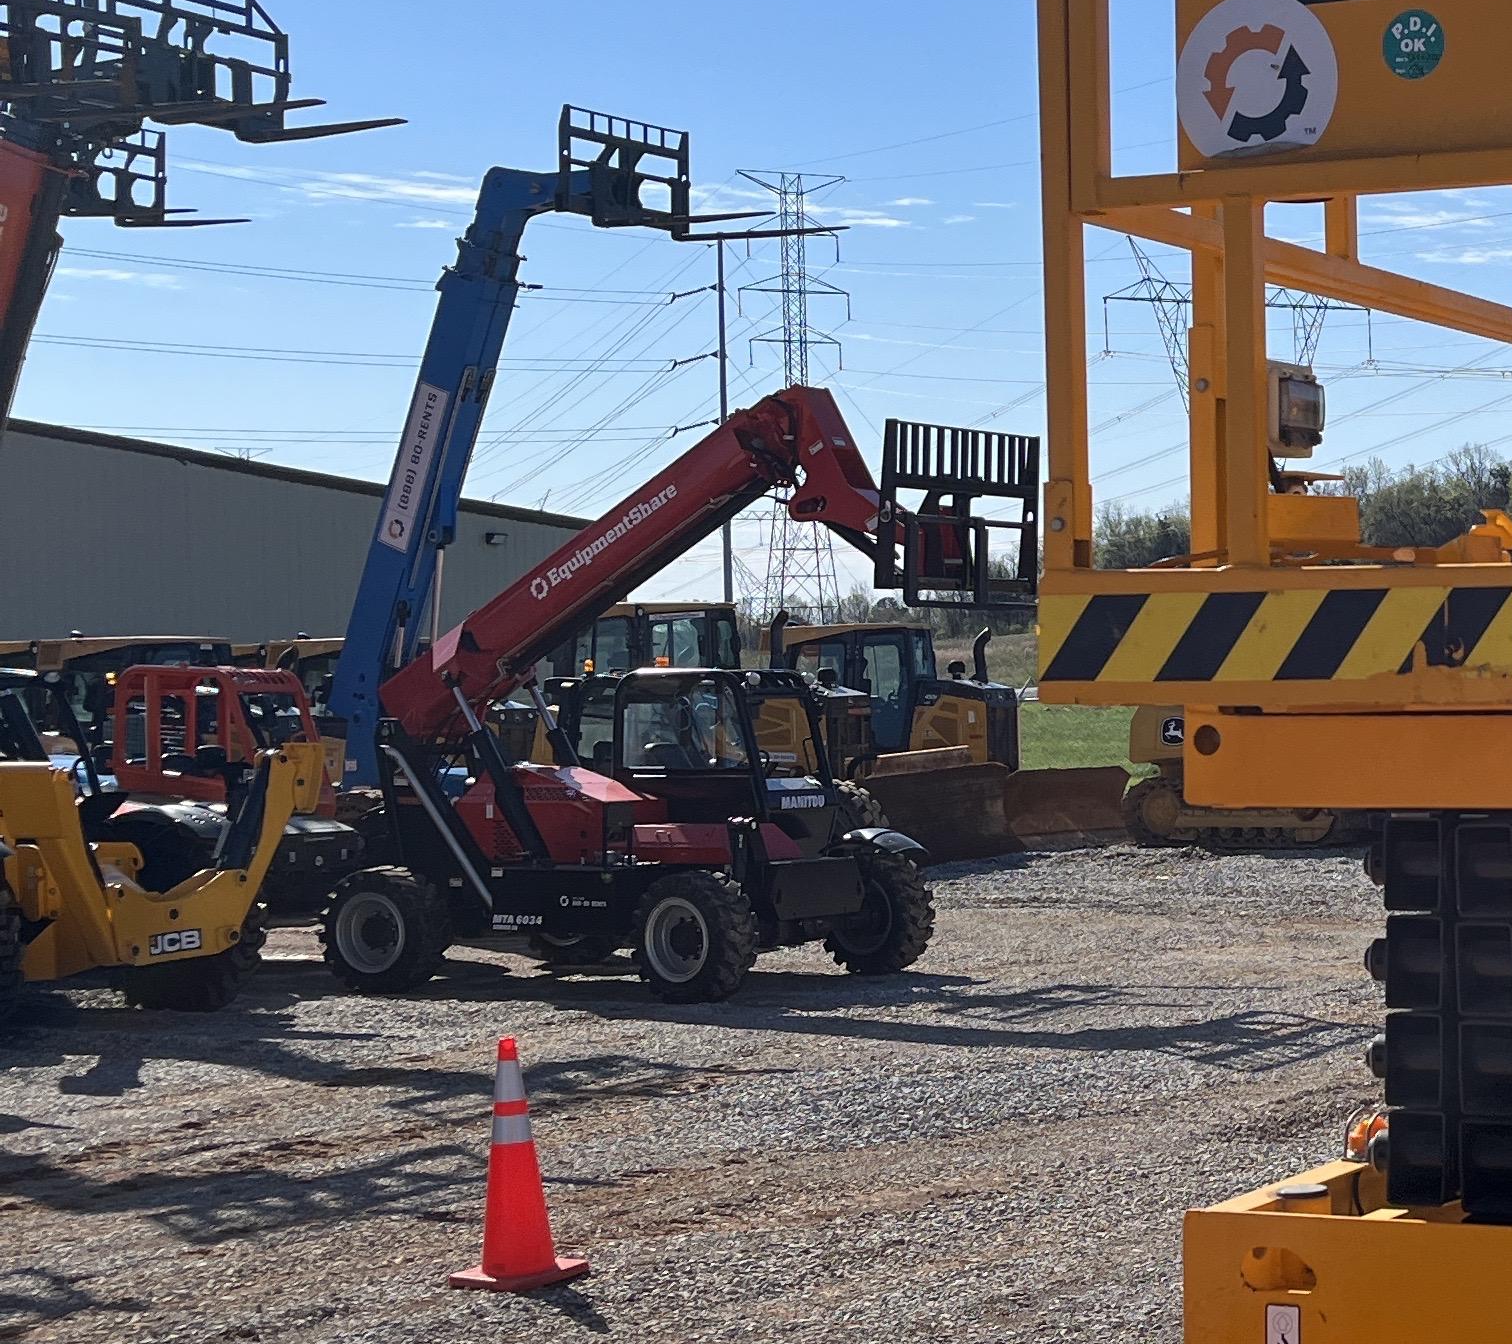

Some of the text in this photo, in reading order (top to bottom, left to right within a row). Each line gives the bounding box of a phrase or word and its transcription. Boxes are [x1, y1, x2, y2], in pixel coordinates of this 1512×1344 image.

[1391, 16, 1437, 42] P.D.I.
[1400, 38, 1427, 53] OK
[545, 484, 679, 588] EquipmentShare
[781, 794, 826, 810] MANITOU
[515, 915, 543, 926] 6034
[150, 930, 202, 956] JCB
